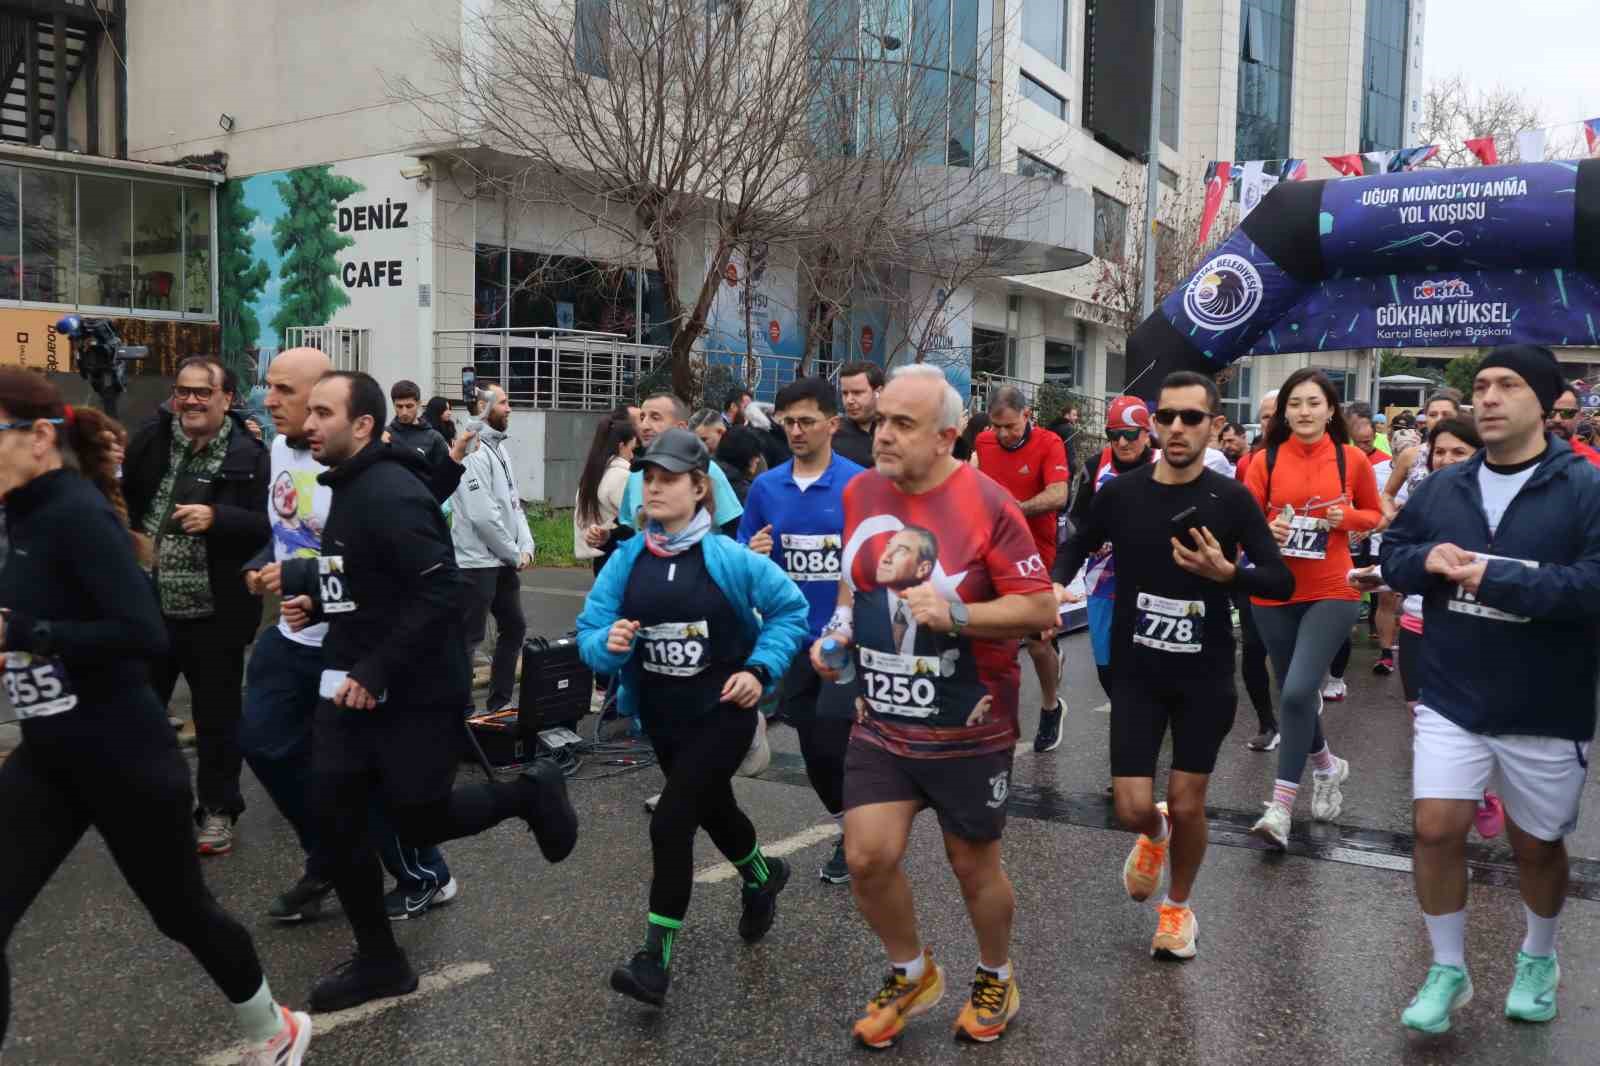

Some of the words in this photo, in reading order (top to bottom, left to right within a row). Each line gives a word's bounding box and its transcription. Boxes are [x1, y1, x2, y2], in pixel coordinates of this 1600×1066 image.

[1362, 188, 1399, 206] UĞUR
[1483, 179, 1528, 198] ANMA
[338, 197, 408, 233] DENİZ
[1399, 206, 1426, 224] YOL
[1428, 202, 1486, 224] KOŞUSU
[342, 260, 402, 288] CAFE
[1376, 303, 1443, 326] GÖKHAN
[1447, 300, 1512, 324] YÜKSEL
[1377, 328, 1411, 339] Kartal
[1414, 327, 1462, 339] Belediye
[1465, 326, 1512, 337] Başkanı
[784, 550, 840, 572] 1086
[1145, 613, 1193, 642] 778
[644, 640, 704, 666] 1189
[863, 672, 936, 707] 1250
